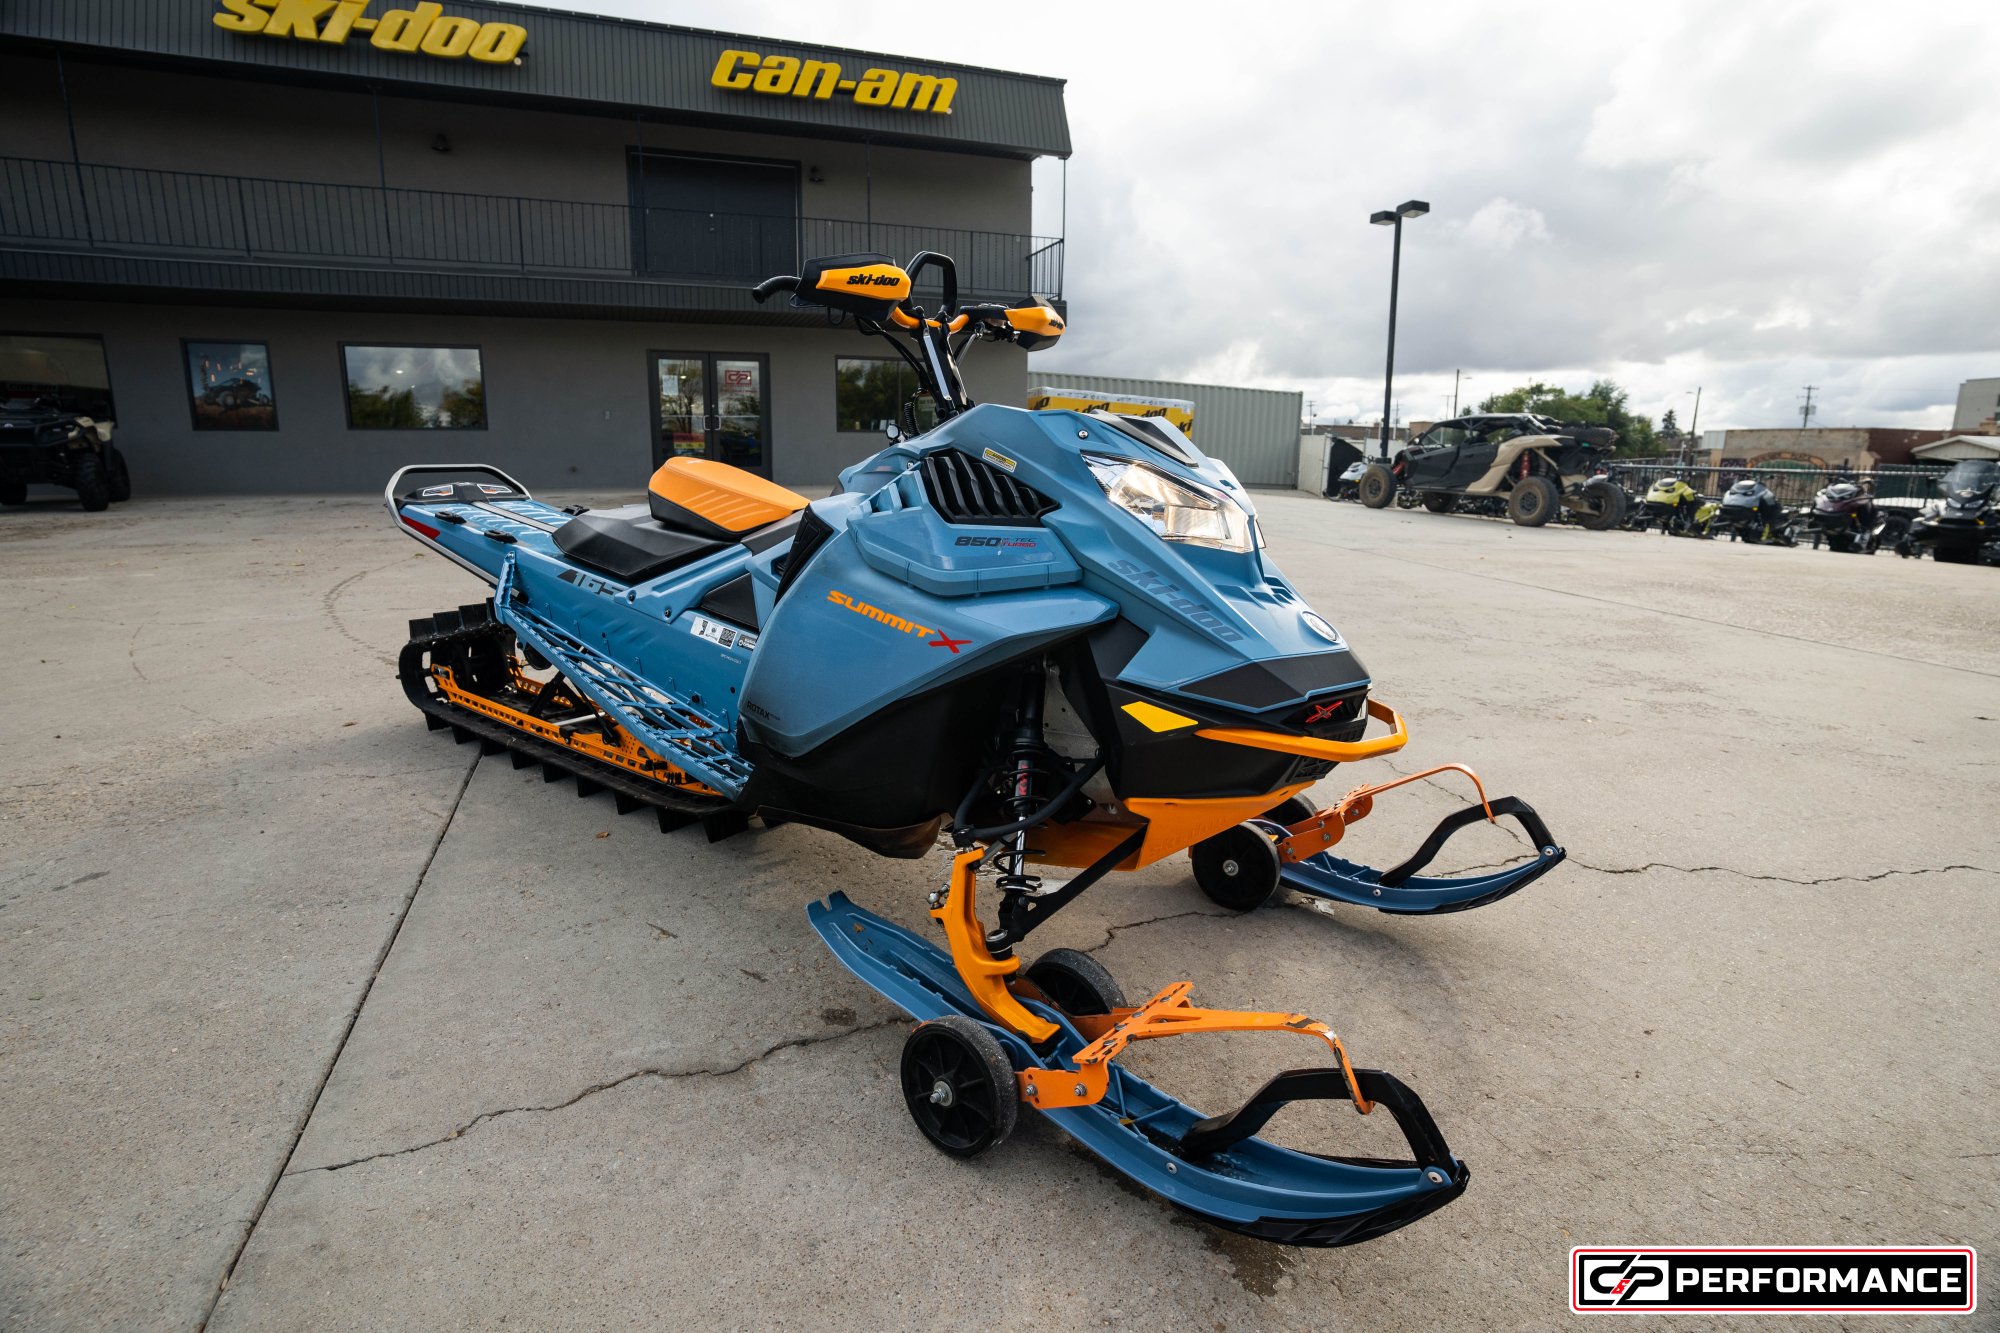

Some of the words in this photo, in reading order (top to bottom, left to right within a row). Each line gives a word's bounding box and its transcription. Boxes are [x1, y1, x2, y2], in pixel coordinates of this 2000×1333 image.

[212, 0, 528, 65] ski-doo
[710, 49, 958, 114] can-am
[846, 273, 901, 287] ski-doo
[954, 536, 1002, 547] 850
[826, 589, 936, 638] SUMMIT
[927, 627, 974, 654] X
[1107, 559, 1245, 643] ski-doo
[746, 700, 770, 720] ROTAX
